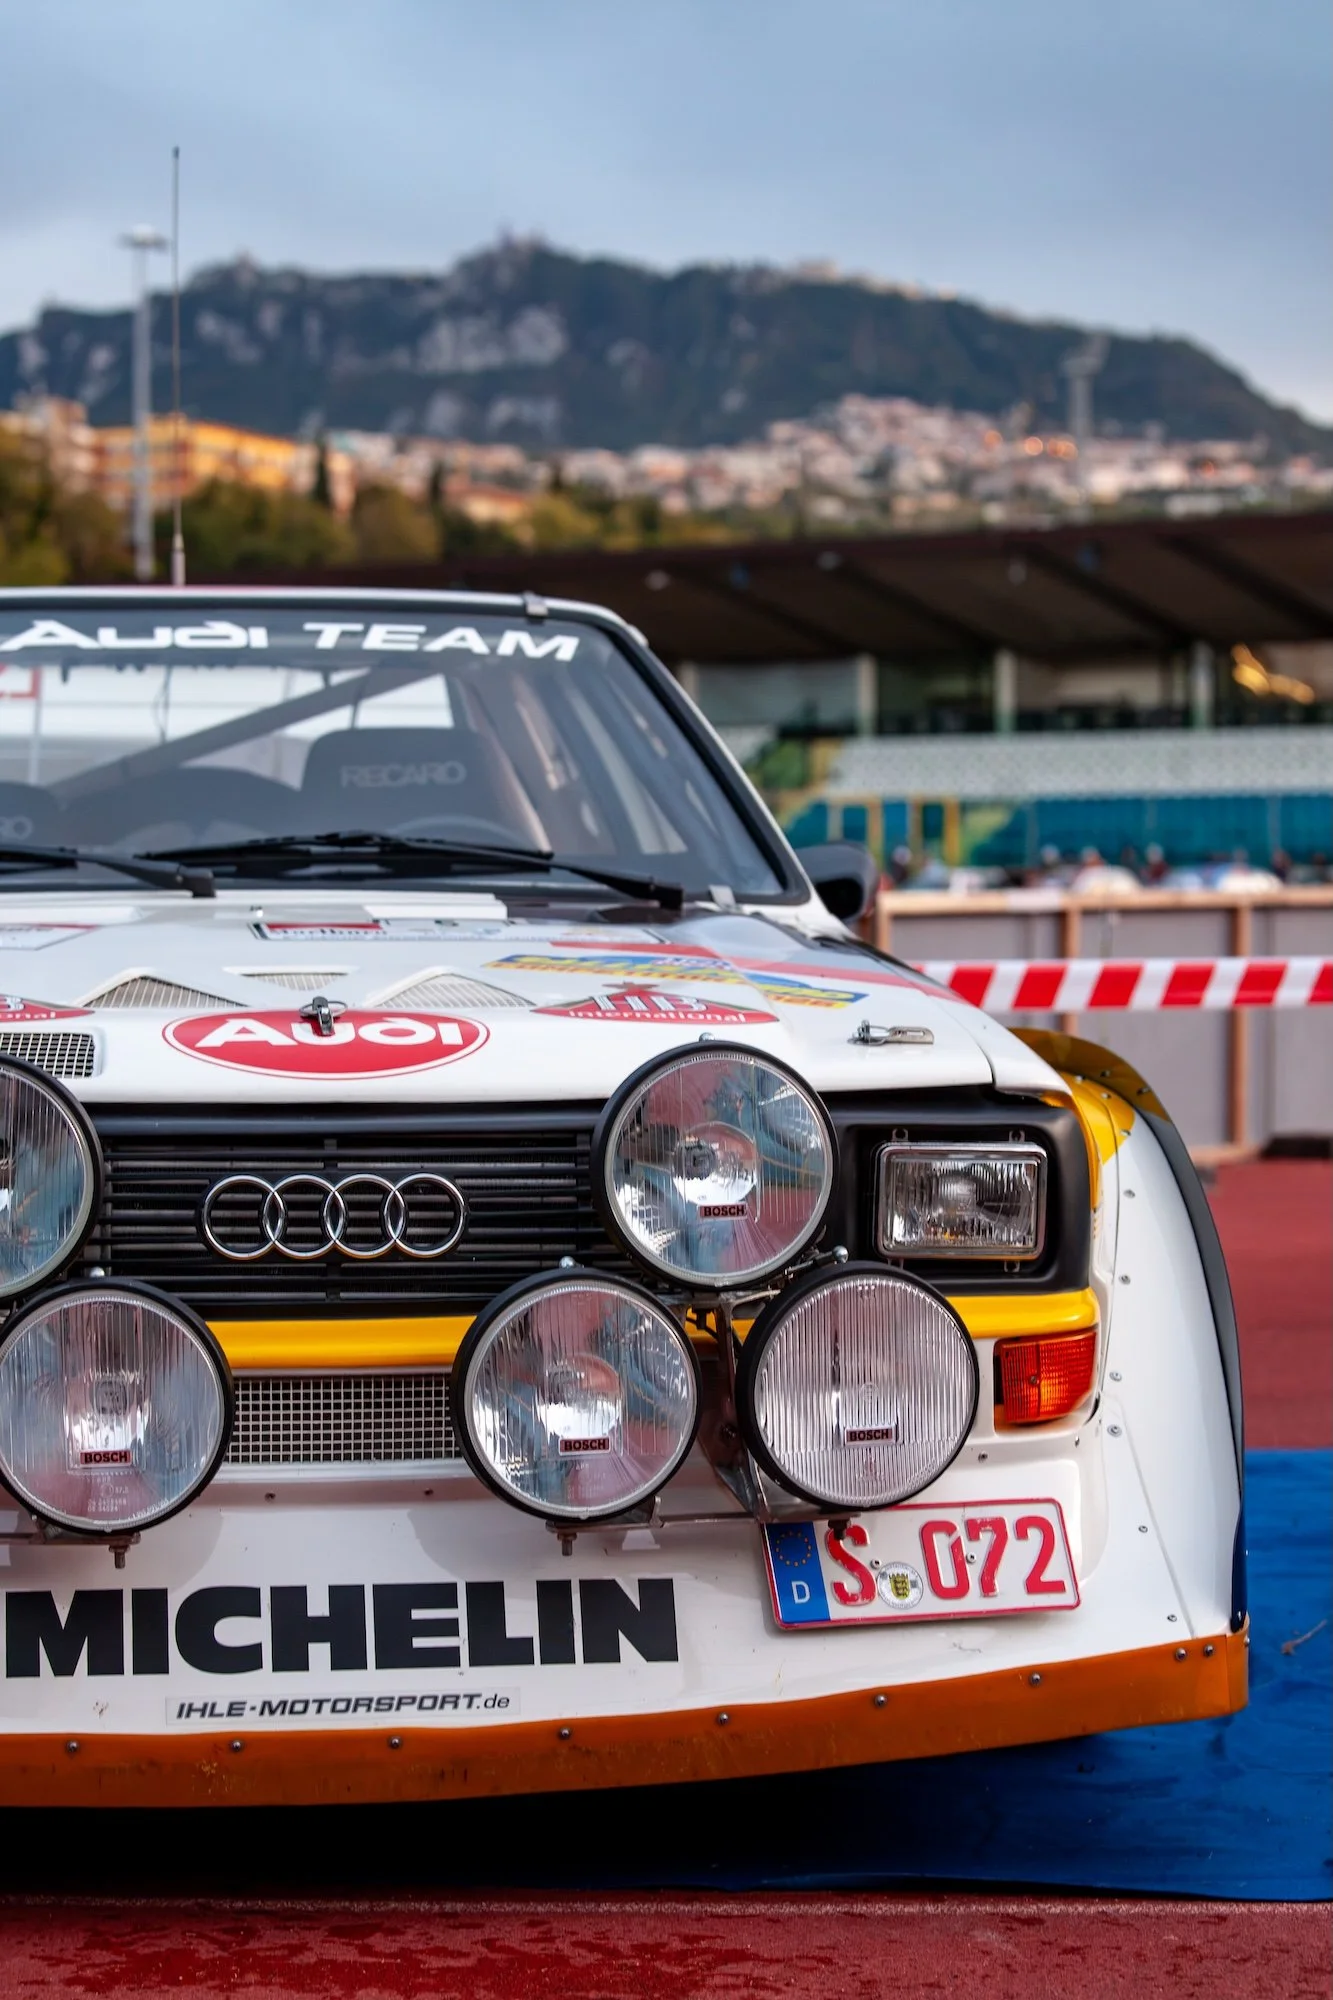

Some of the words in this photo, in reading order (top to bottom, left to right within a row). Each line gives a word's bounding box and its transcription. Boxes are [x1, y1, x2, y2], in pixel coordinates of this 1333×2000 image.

[303, 623, 579, 661] TEAM
[340, 762, 466, 788] RECARO
[704, 1206, 745, 1217] BOSCH
[564, 1439, 606, 1451] BOSCH
[850, 1429, 889, 1440] BOSCH
[84, 1451, 128, 1464] BOSCH
[825, 1525, 877, 1605] S
[919, 1516, 1066, 1600] 072
[793, 1581, 811, 1604] D
[5, 1578, 679, 1678] MICHELIN
[176, 1693, 511, 1719] IHLE-MOTORSPORT.de
